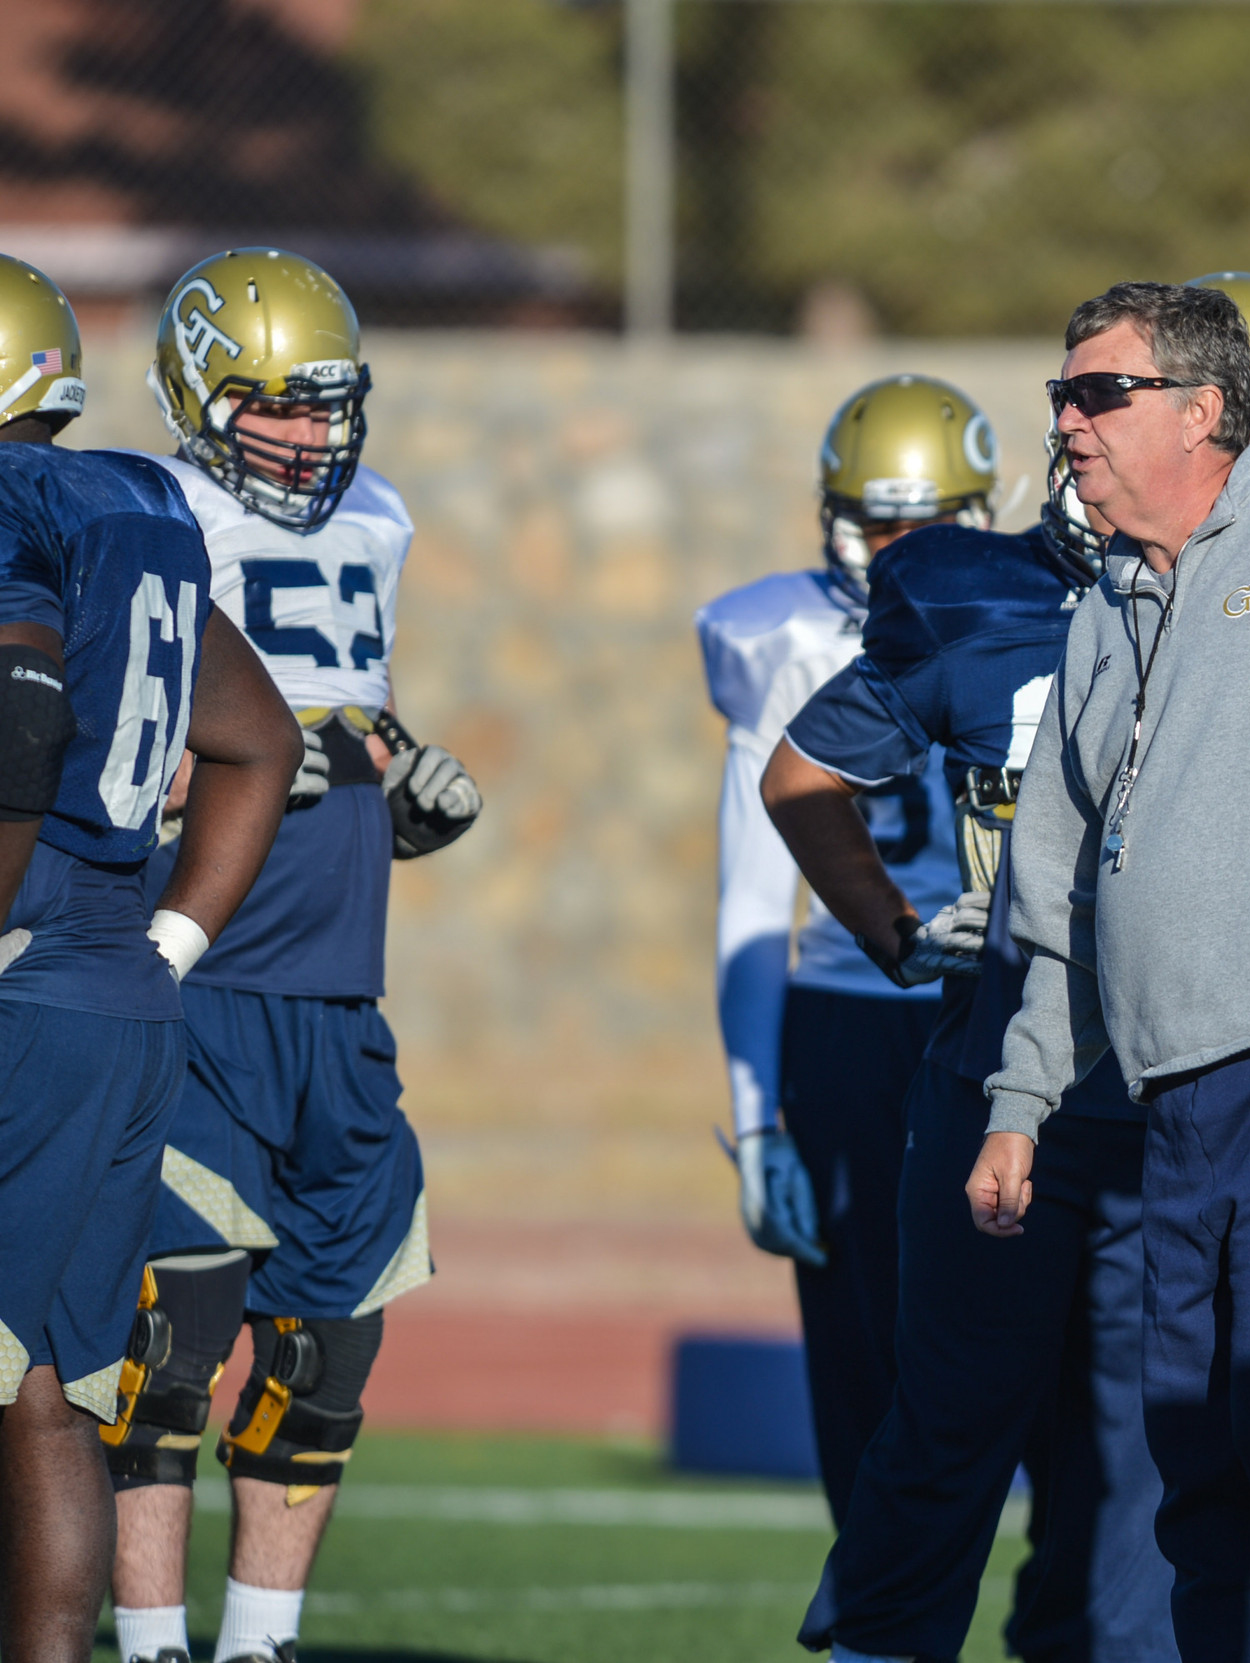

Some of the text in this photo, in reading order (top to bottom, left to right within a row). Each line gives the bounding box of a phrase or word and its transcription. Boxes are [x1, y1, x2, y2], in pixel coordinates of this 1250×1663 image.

[172, 277, 243, 371] GT
[311, 365, 338, 377] ACC
[98, 571, 198, 836] 61
